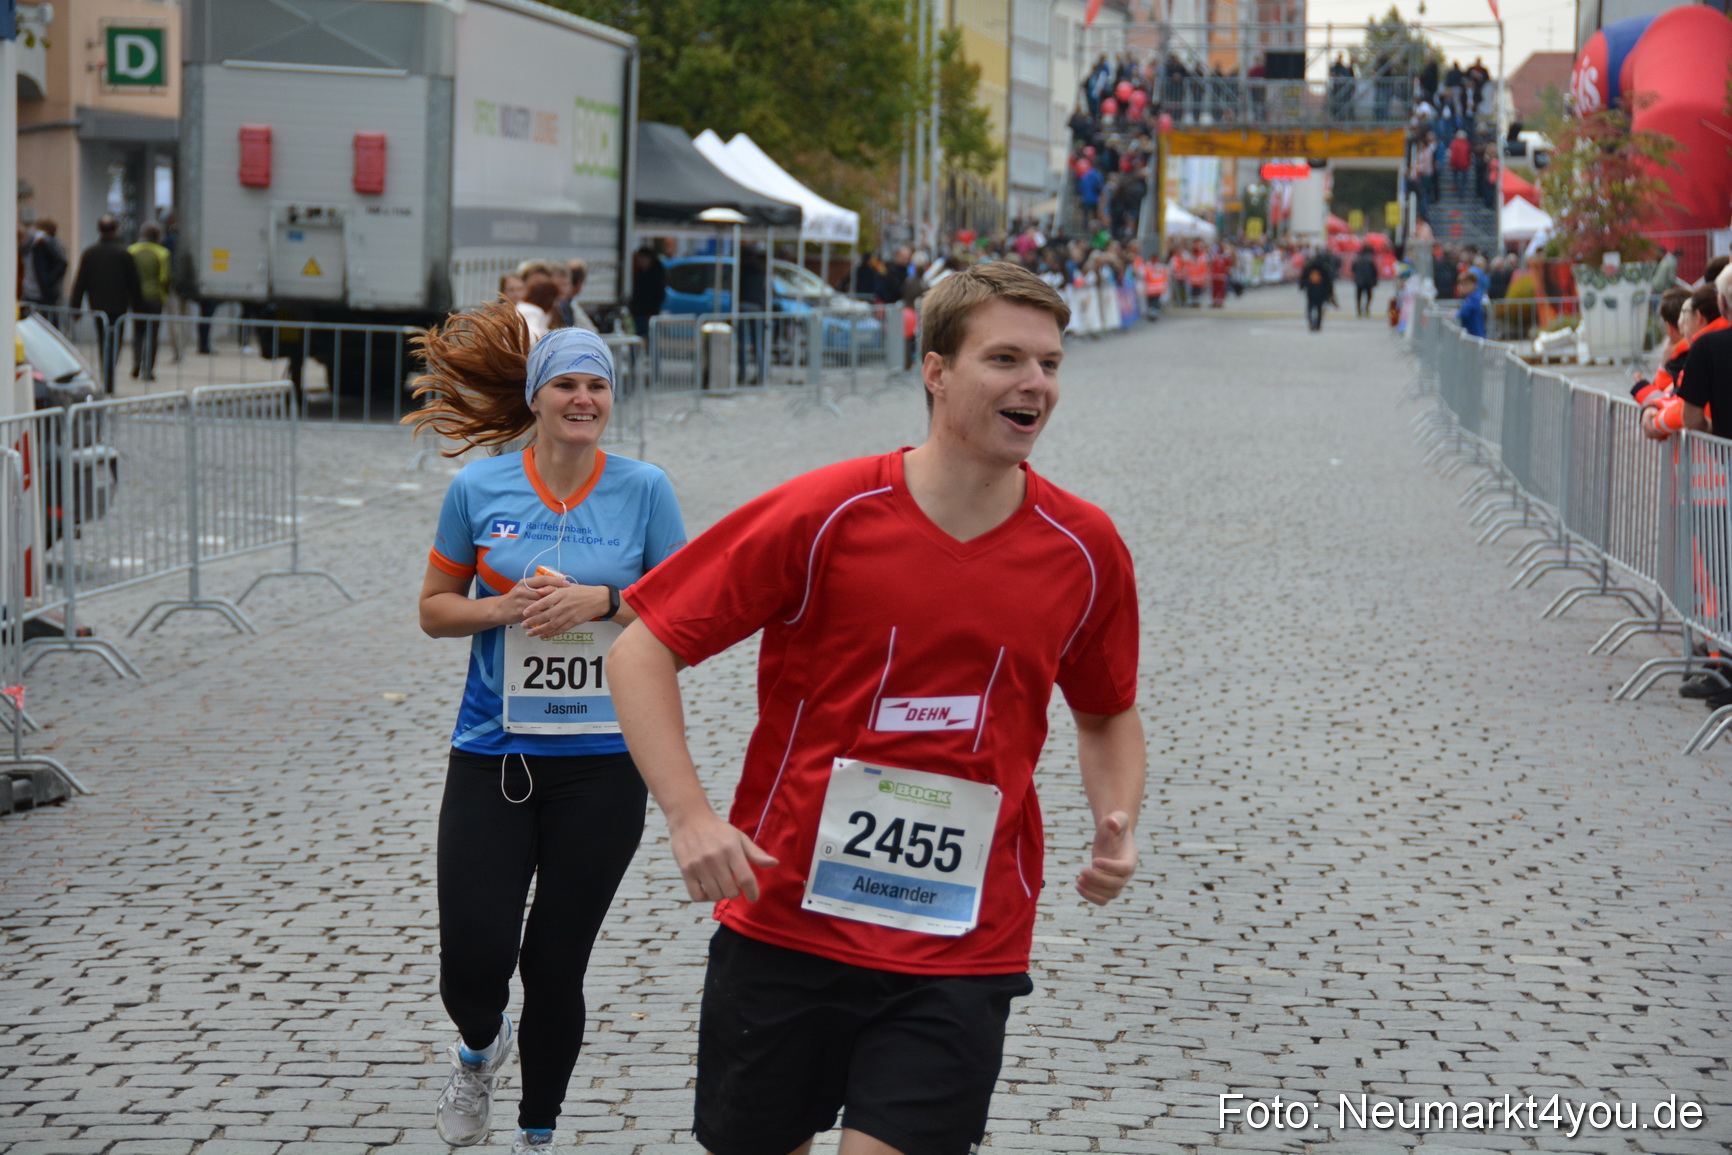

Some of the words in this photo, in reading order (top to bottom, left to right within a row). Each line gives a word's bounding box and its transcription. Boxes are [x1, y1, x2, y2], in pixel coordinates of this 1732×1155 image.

[115, 34, 158, 79] D
[525, 521, 593, 535] Raiffeisenbank
[523, 531, 573, 543] Neumakt
[607, 538, 620, 547] eG
[553, 631, 594, 642] BOCK
[523, 655, 603, 690] 2501
[544, 702, 588, 715] Jasmin
[904, 706, 951, 721] DEHN
[895, 782, 952, 805] BOCK
[842, 810, 966, 873] 2455
[825, 845, 832, 855] D
[852, 875, 938, 905] Alexander
